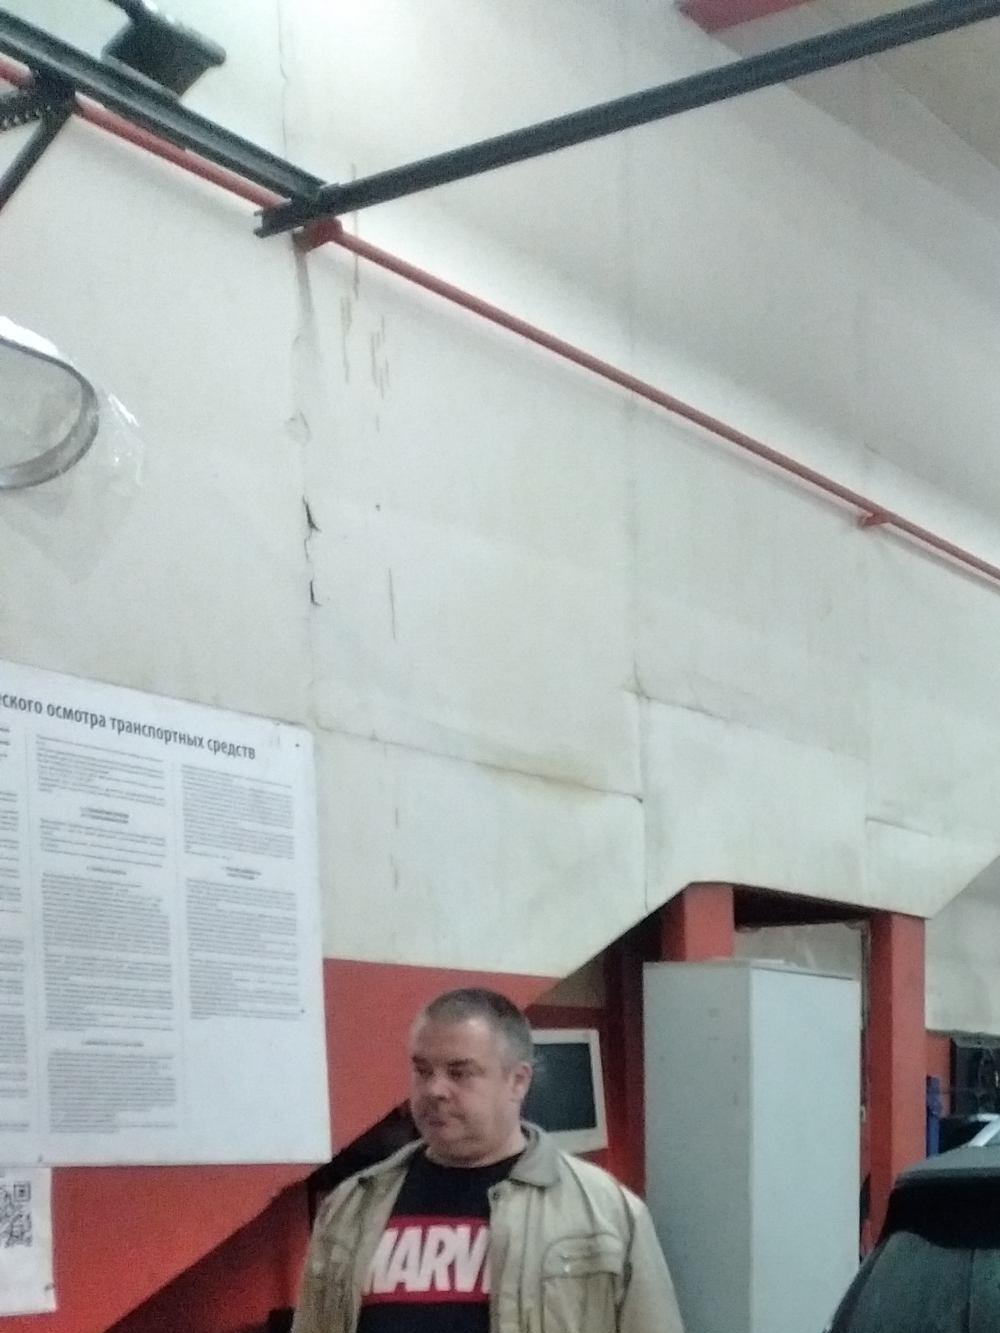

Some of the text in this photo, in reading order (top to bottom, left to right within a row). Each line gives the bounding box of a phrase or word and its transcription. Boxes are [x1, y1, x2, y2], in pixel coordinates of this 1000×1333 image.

[0, 693, 256, 761] ского осмотра транспортных средств
